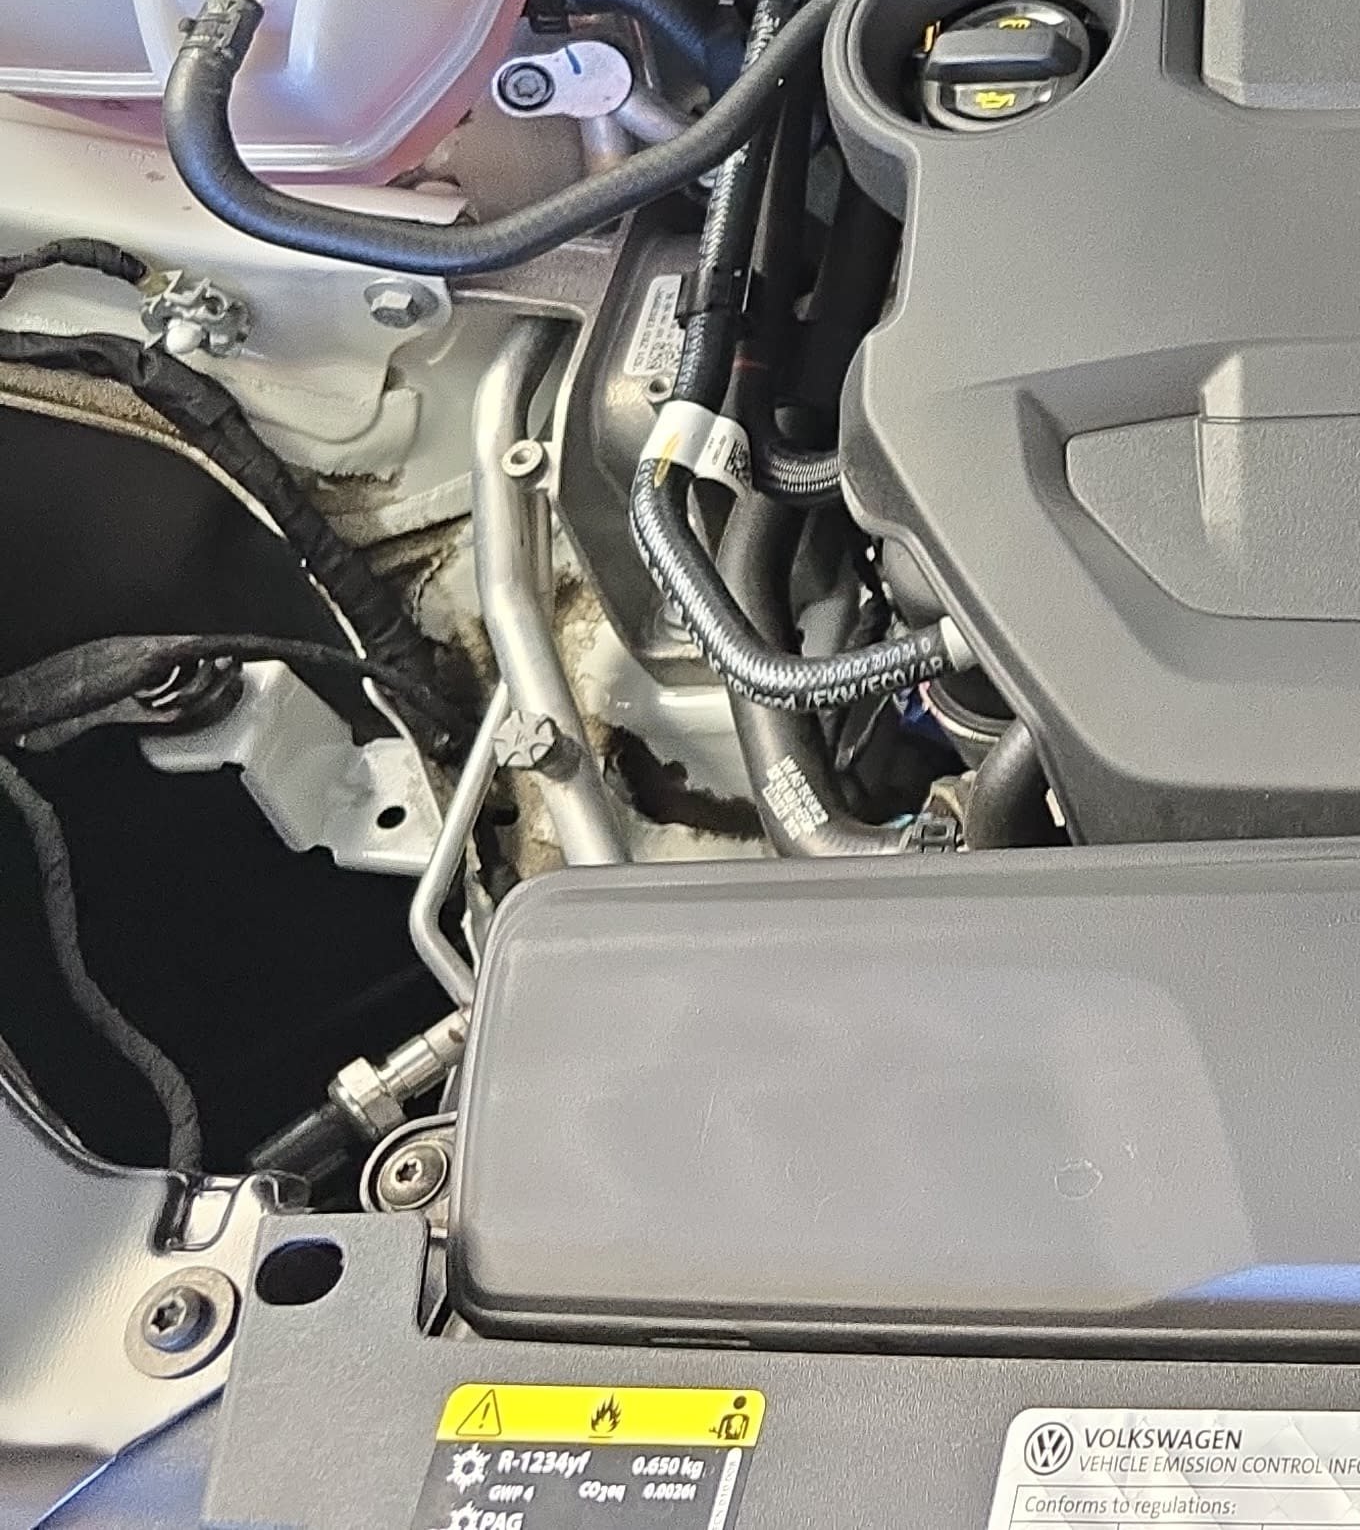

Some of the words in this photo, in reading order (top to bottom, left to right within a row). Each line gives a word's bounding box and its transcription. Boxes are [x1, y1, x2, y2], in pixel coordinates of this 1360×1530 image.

[1084, 1428, 1243, 1451] VOLKSWAGEN
[632, 1456, 680, 1476] 0.650
[681, 1456, 704, 1479] kg
[1079, 1455, 1150, 1473] VEHICLE
[1153, 1455, 1236, 1474] EMISSION
[1242, 1457, 1323, 1475] CONTROL
[488, 1484, 522, 1502] GWP
[1024, 1495, 1107, 1516] Conforms
[1112, 1497, 1130, 1516] to
[1134, 1496, 1236, 1520] regulations:
[480, 1512, 524, 1530] PAG
